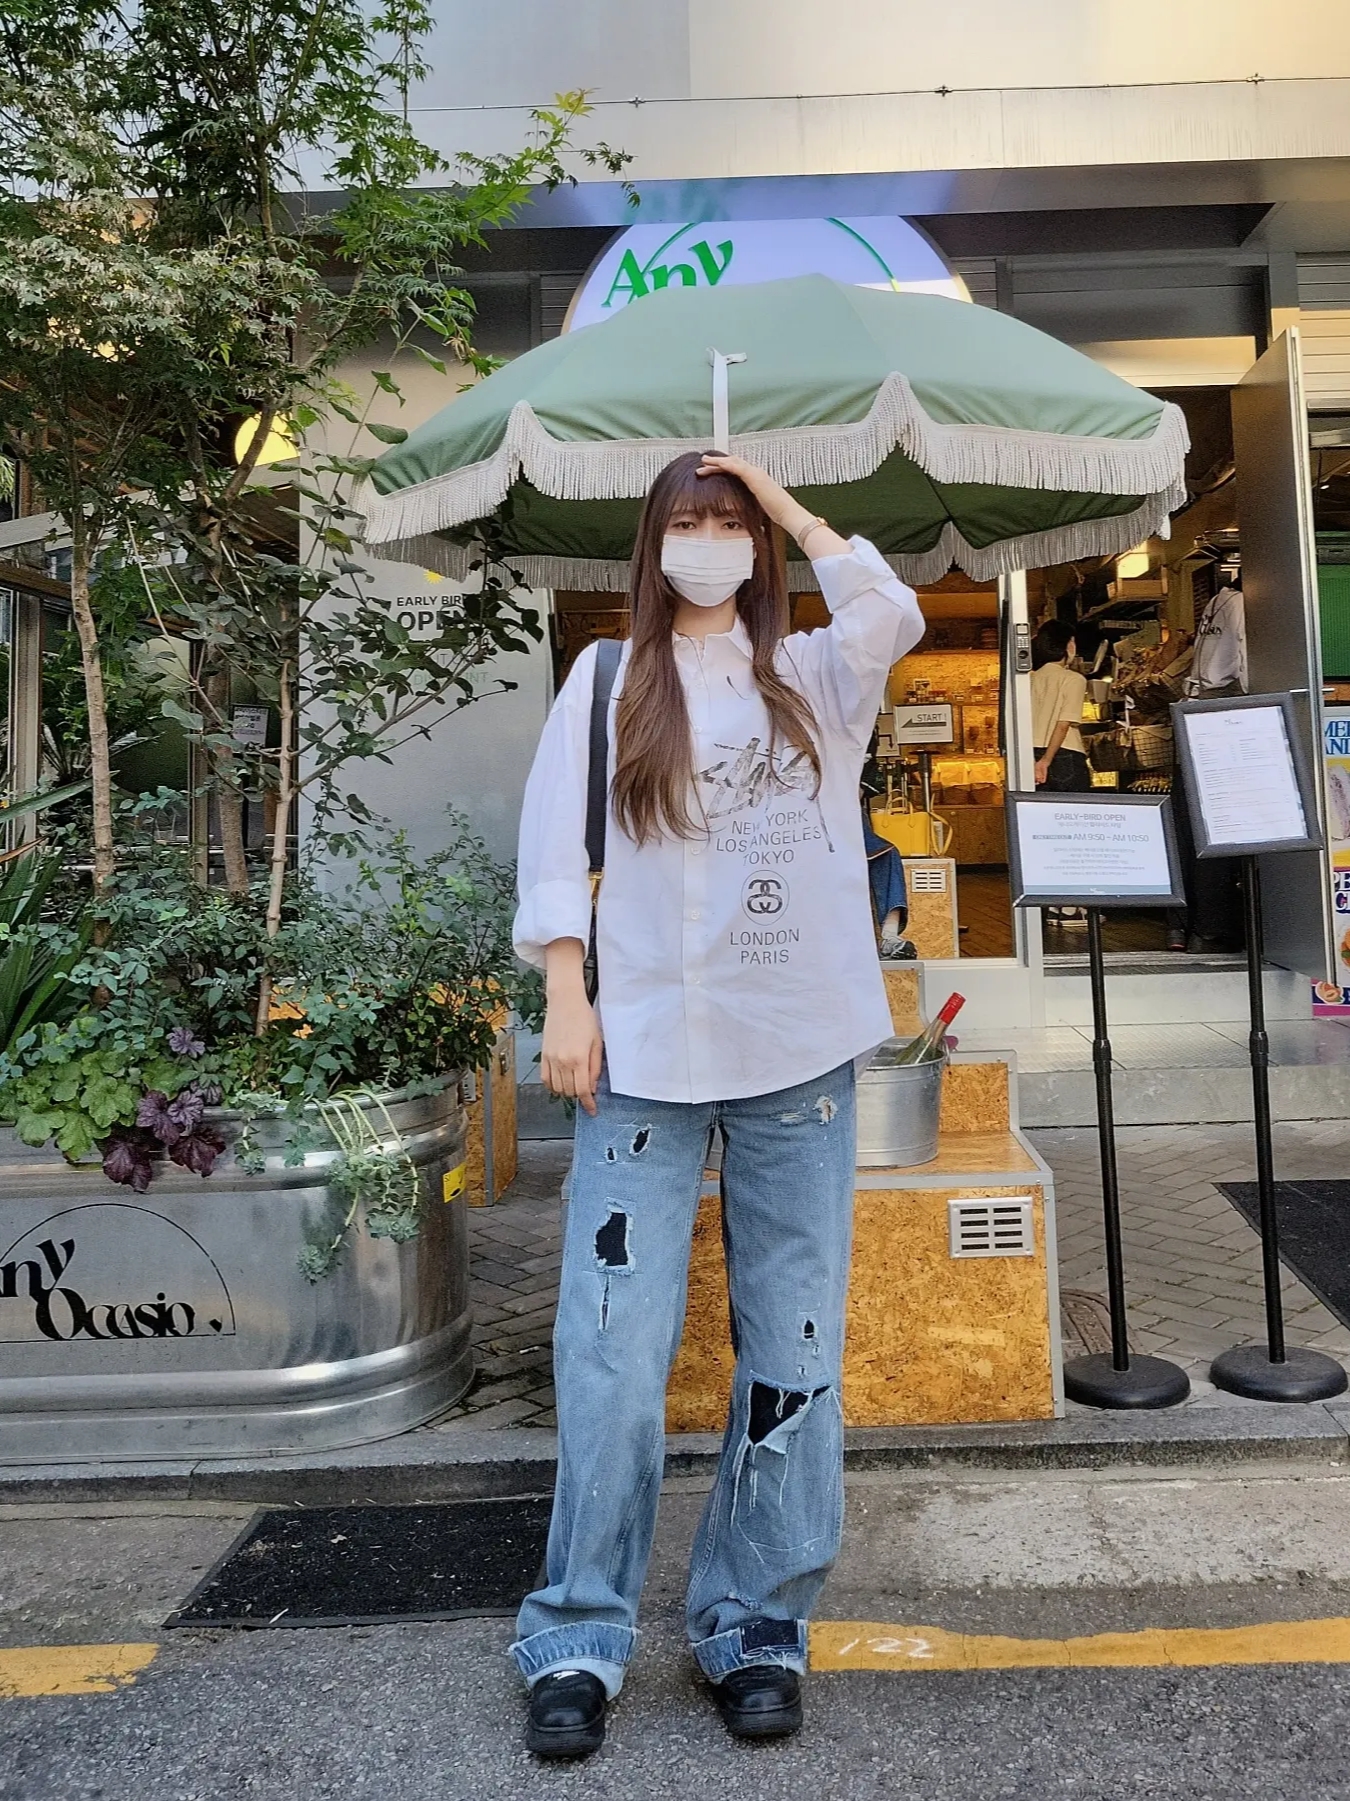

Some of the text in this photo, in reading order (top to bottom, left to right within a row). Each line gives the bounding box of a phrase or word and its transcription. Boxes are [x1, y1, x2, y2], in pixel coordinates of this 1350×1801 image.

[397, 595, 464, 606] EARLY BIR
[917, 713, 942, 721] START
[766, 809, 808, 826] YORK
[1054, 813, 1126, 822] EARLY-BIRD OPEN
[716, 826, 822, 853] LOS ANGELES
[1073, 833, 1087, 841] AM
[1112, 834, 1126, 842] AM
[743, 849, 795, 866] TOKYO
[730, 928, 800, 946] LONDON
[741, 949, 790, 965] PARIS
